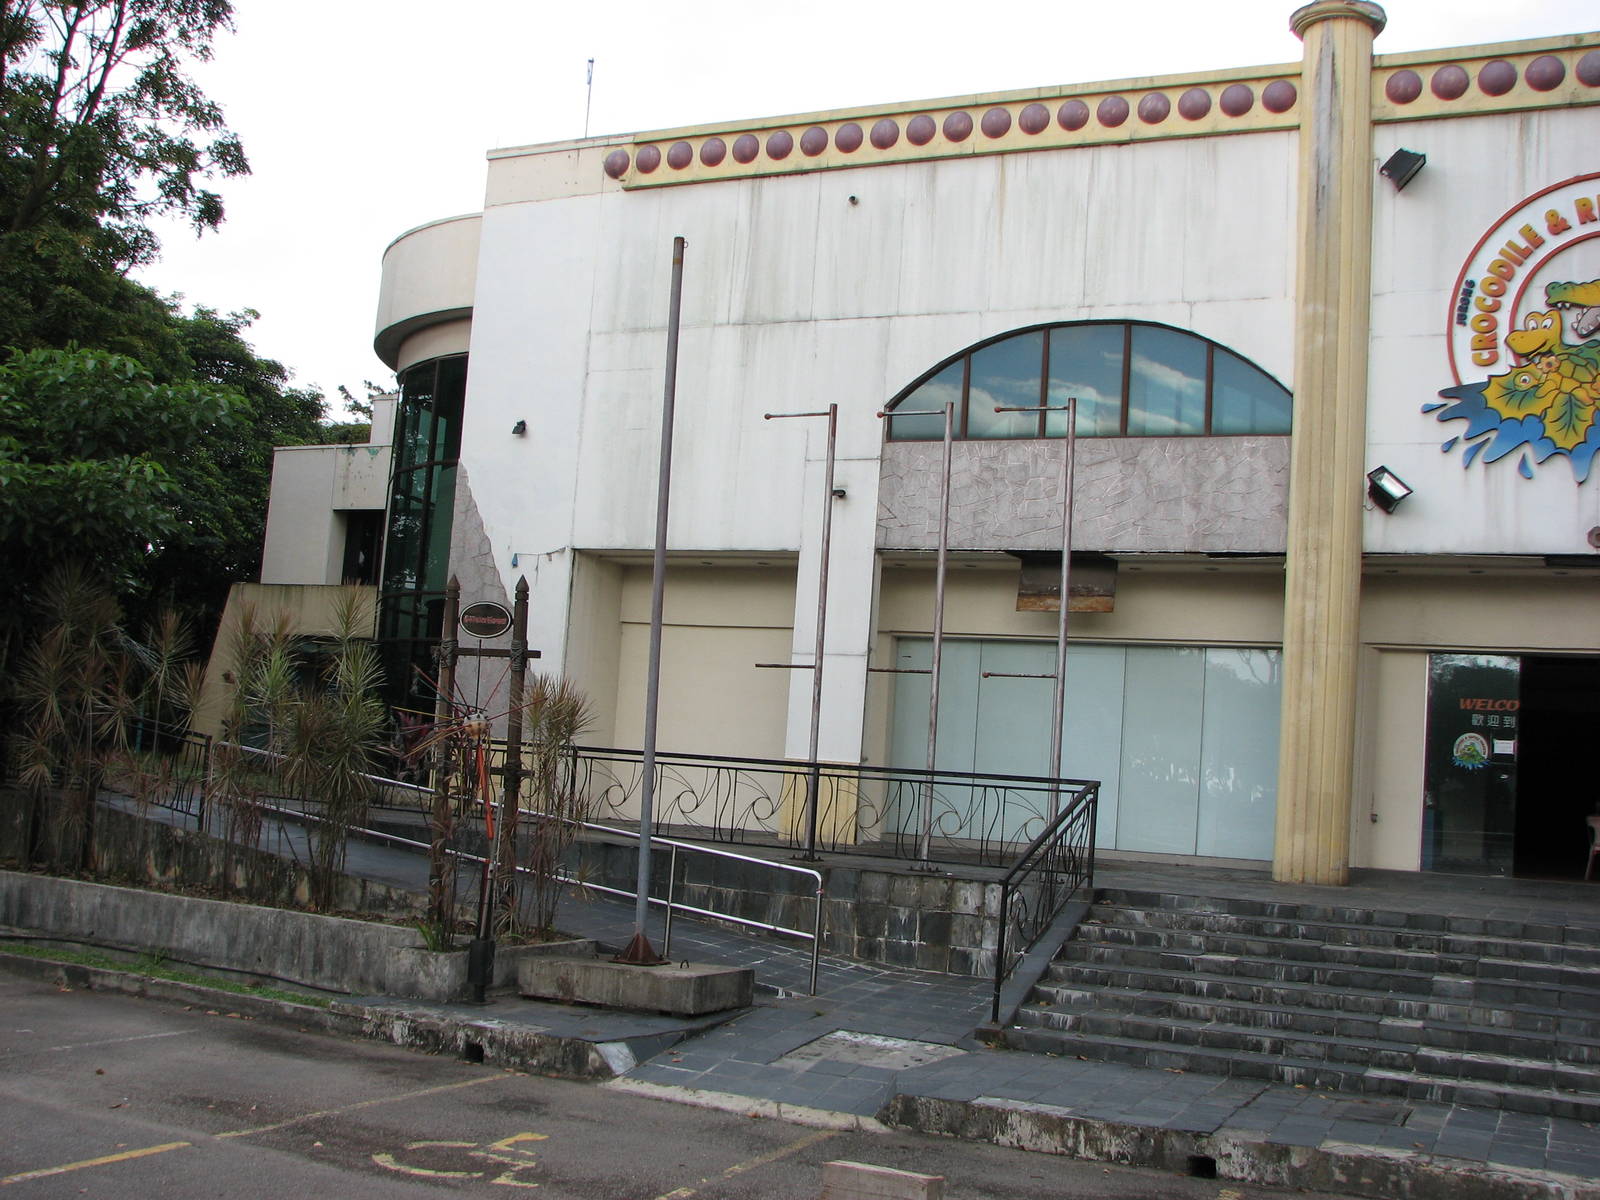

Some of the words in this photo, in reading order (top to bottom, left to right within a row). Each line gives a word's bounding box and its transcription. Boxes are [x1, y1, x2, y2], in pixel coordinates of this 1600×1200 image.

[1456, 279, 1475, 327] JURONG
[1471, 223, 1545, 367] CROCODILE
[1544, 209, 1573, 236] &
[1574, 195, 1600, 225] R
[1460, 699, 1521, 711] WELCO
